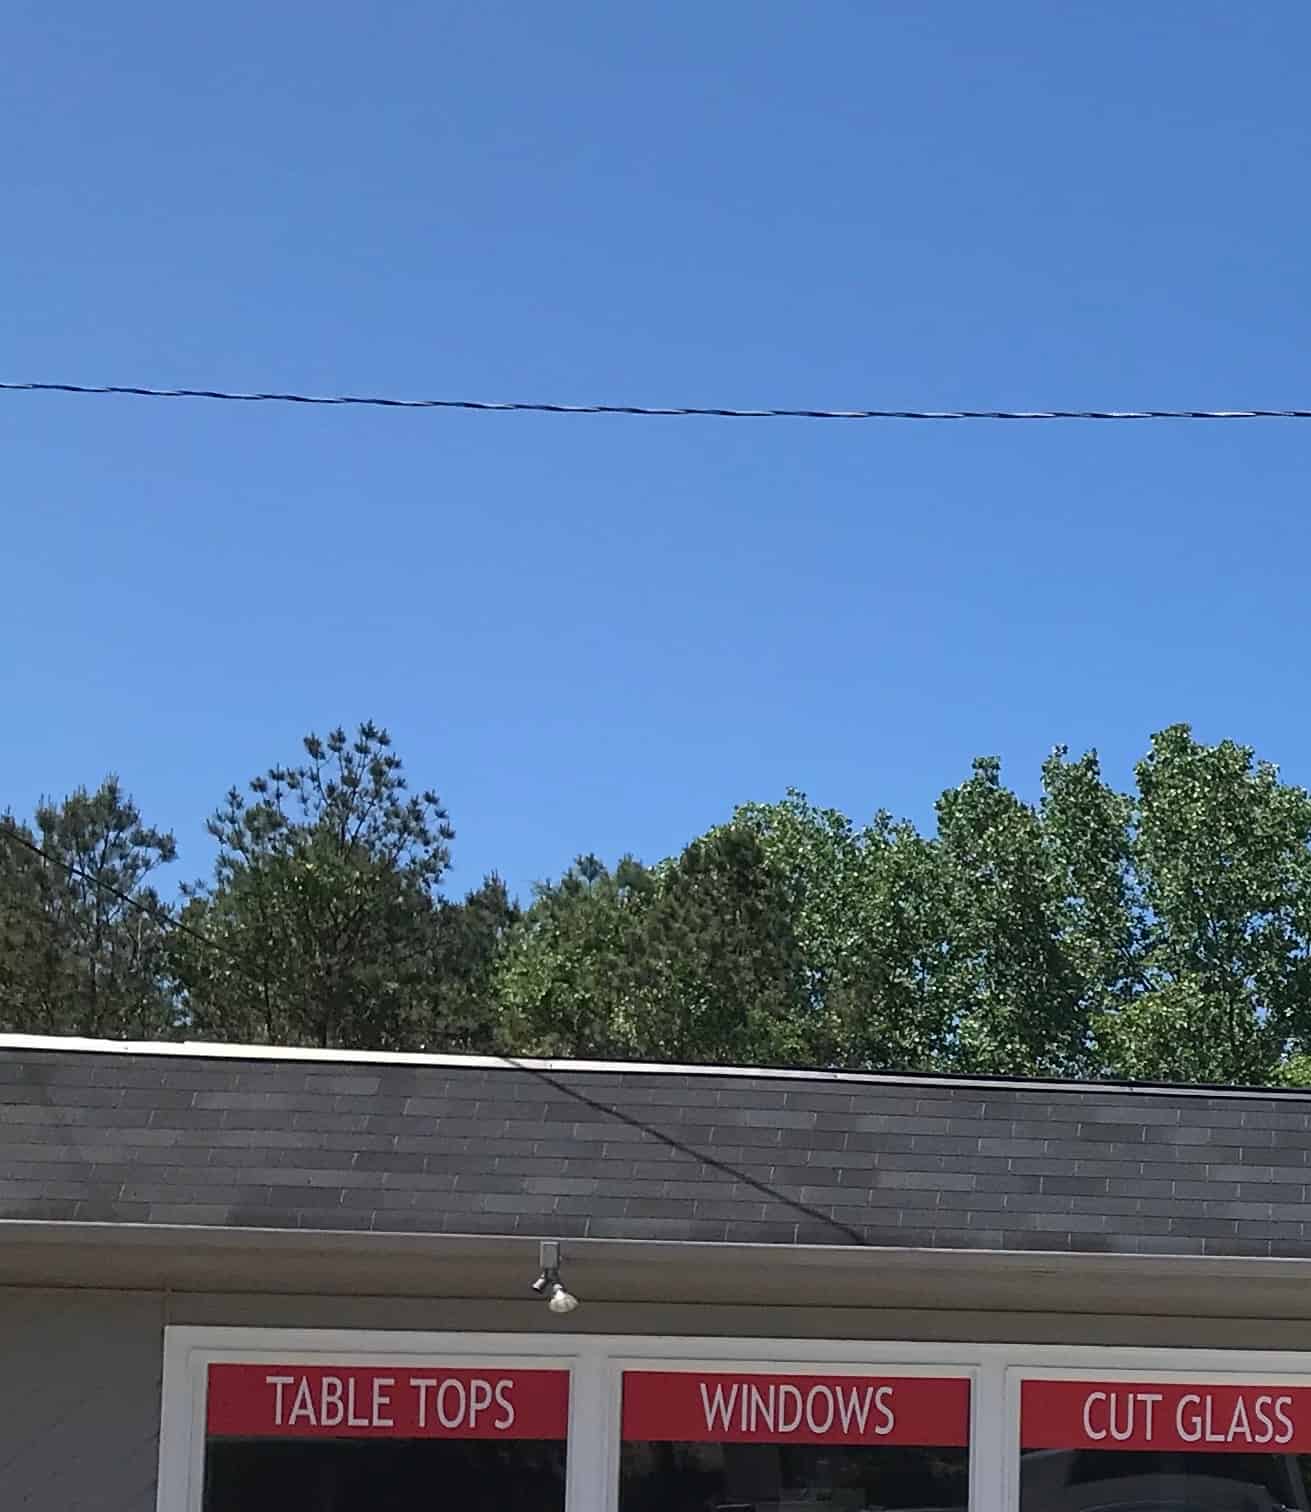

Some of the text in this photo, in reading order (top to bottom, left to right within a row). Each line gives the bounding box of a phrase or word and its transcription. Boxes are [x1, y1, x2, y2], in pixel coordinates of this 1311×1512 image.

[266, 1375, 514, 1429] TABLE TOPS
[700, 1383, 894, 1435] WINDOWS
[1083, 1391, 1294, 1444] CUT GLASS
